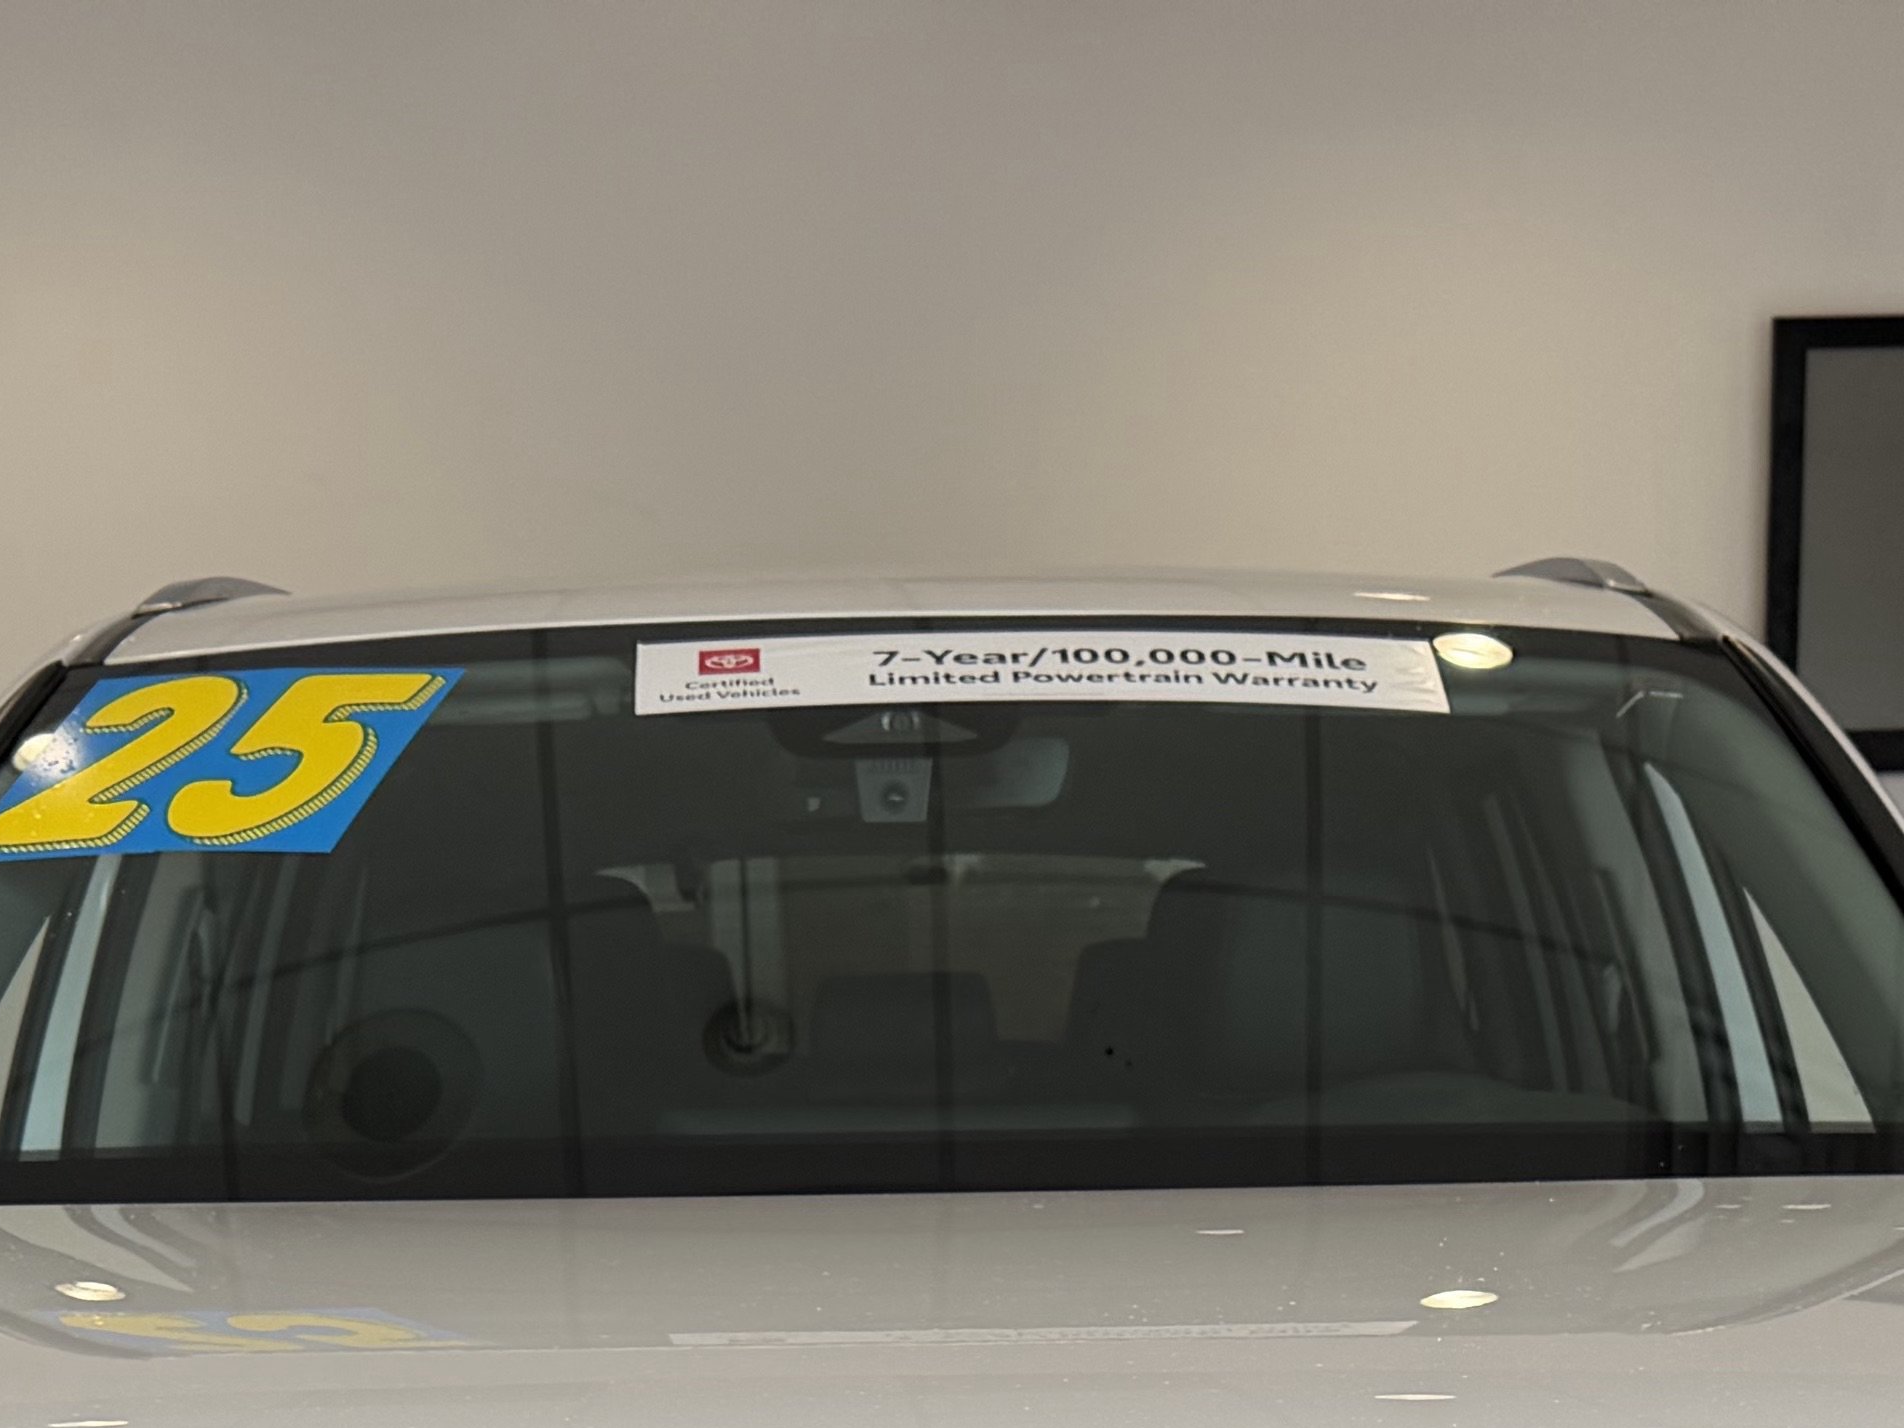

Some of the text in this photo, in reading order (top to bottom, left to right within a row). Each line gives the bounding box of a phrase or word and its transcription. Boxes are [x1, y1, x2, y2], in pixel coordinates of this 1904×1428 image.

[872, 648, 1368, 671] 7-Year/100,000-Mile
[685, 677, 775, 691] Certified
[869, 669, 1378, 694] Limited Powertrain Warranty
[659, 688, 801, 703] Used Vehicles
